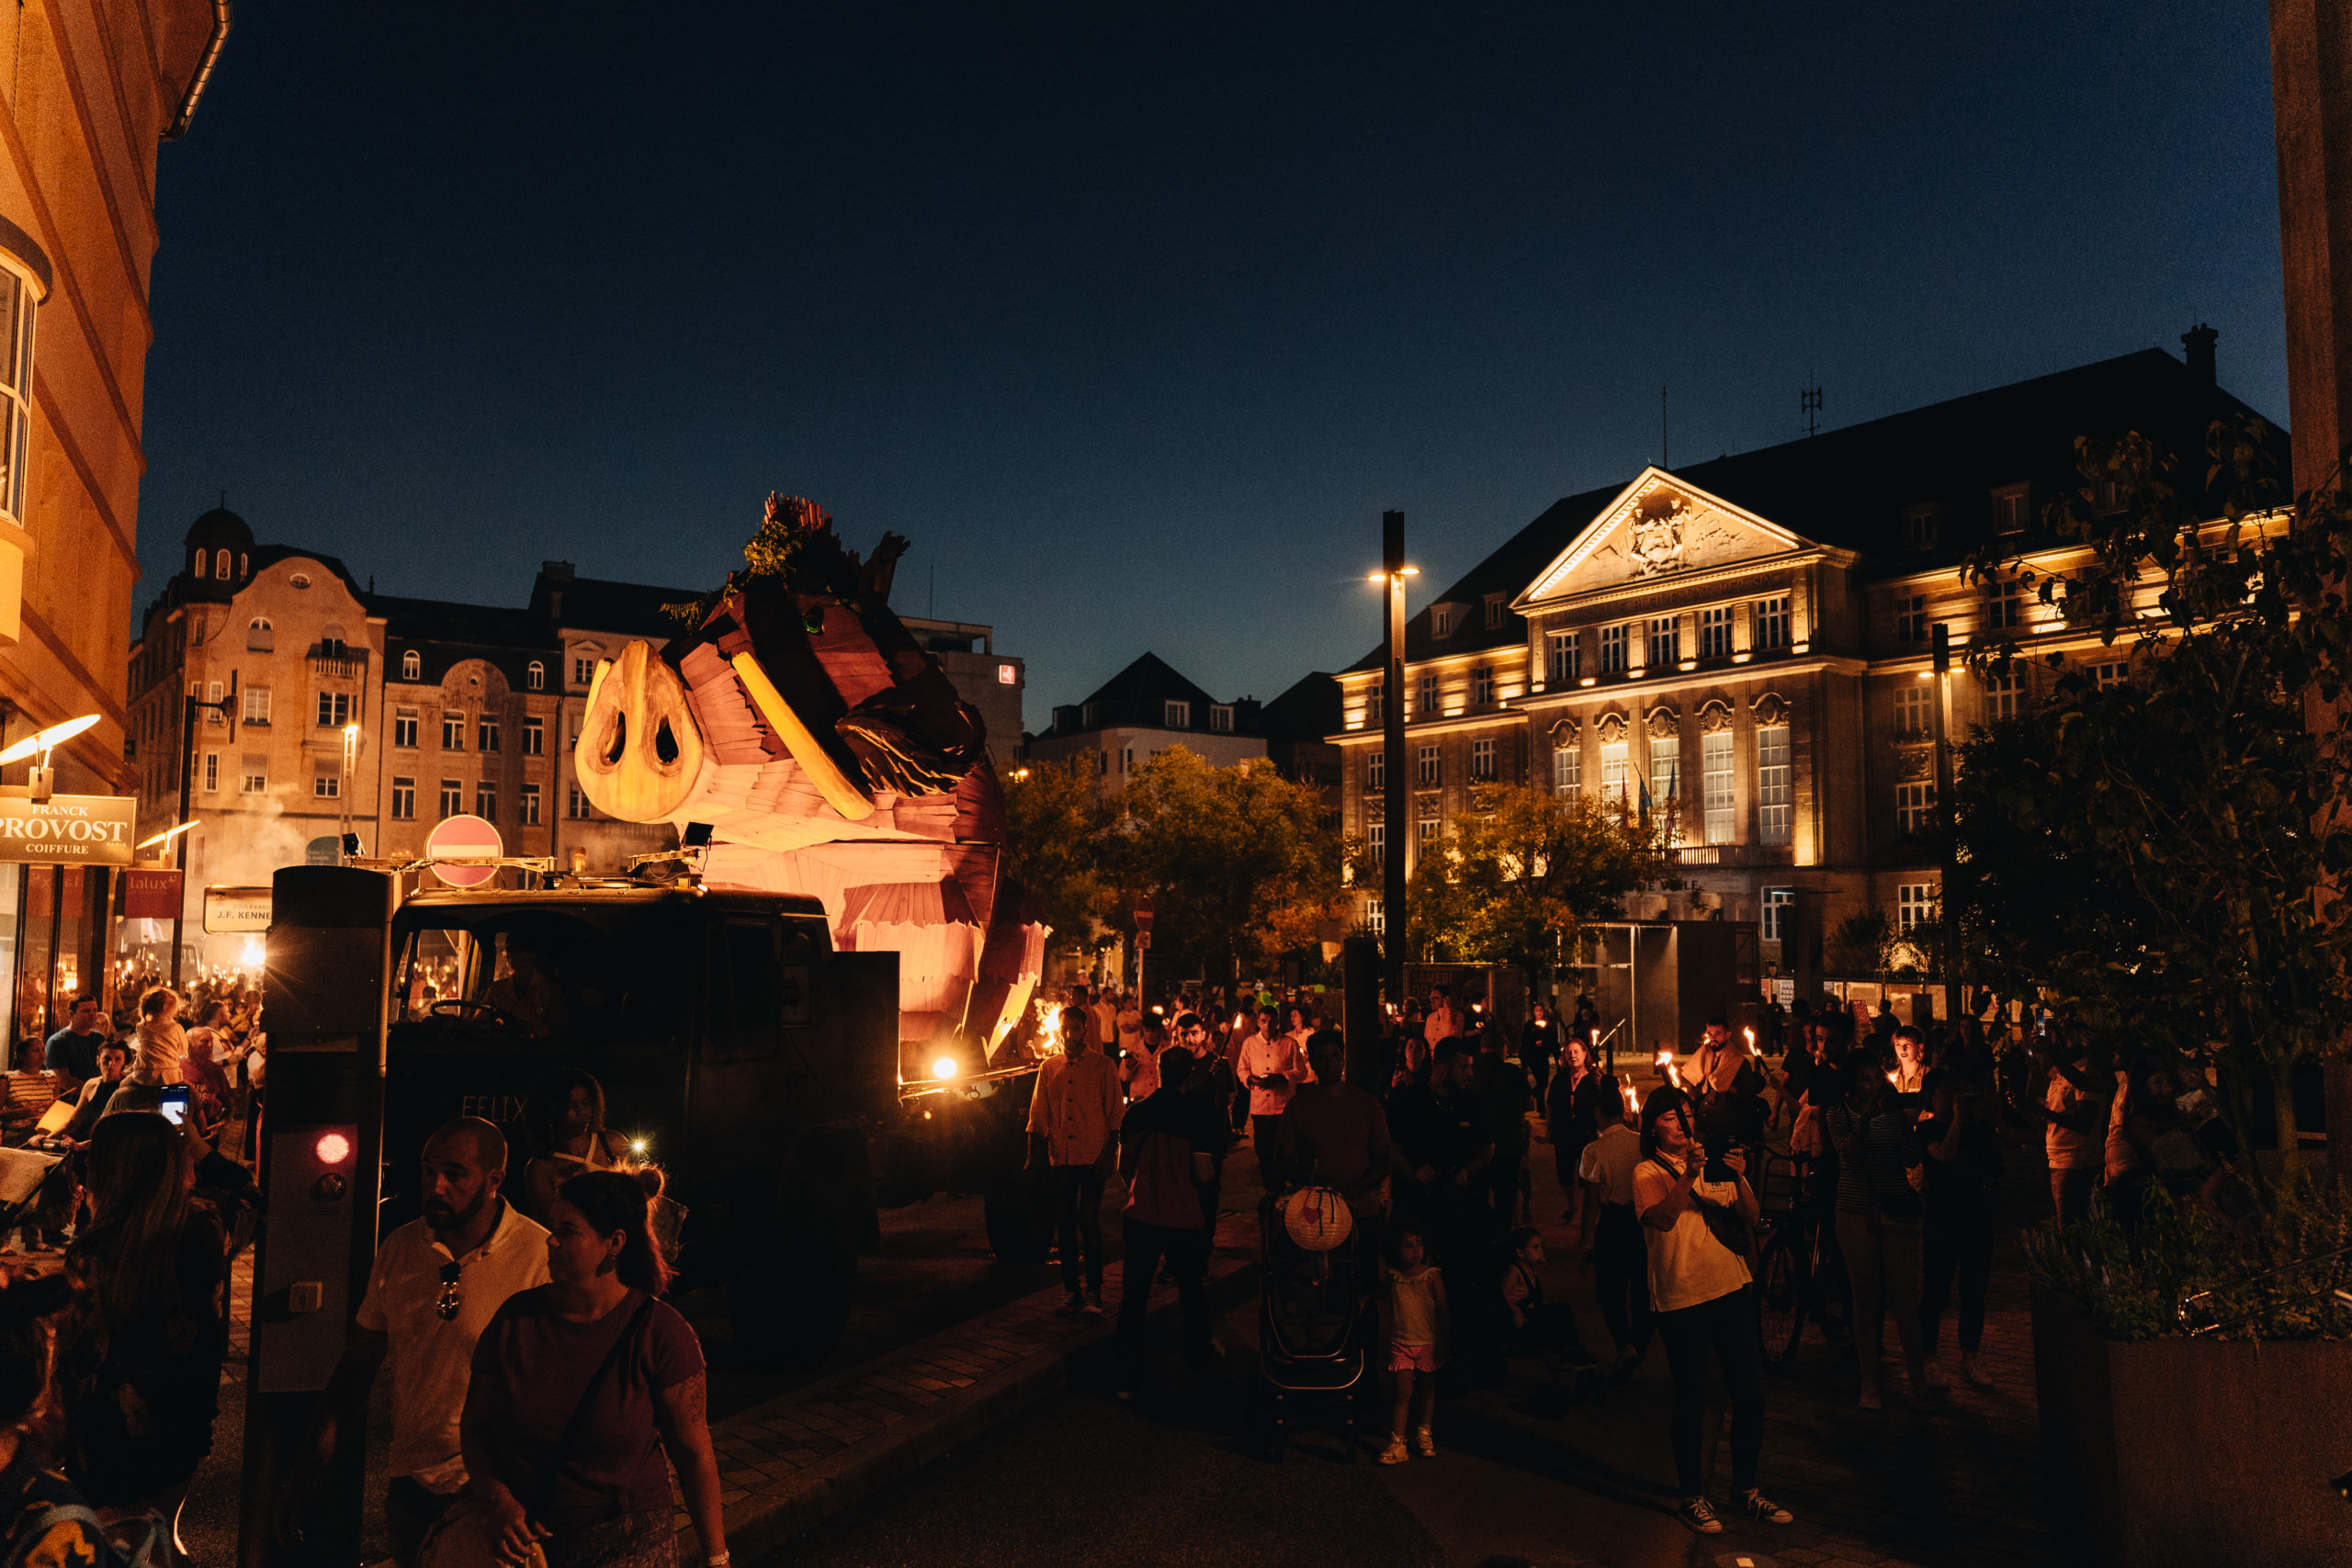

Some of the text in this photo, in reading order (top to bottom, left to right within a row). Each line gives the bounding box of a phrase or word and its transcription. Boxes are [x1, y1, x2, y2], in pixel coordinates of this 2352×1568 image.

[32, 805, 89, 817] FRANCK
[26, 843, 89, 854] COIFFURE
[130, 876, 167, 890] lalux
[1660, 881, 1699, 891] VLE
[218, 911, 272, 919] J.F. KENNE
[1412, 971, 1453, 985] SAMEDI
